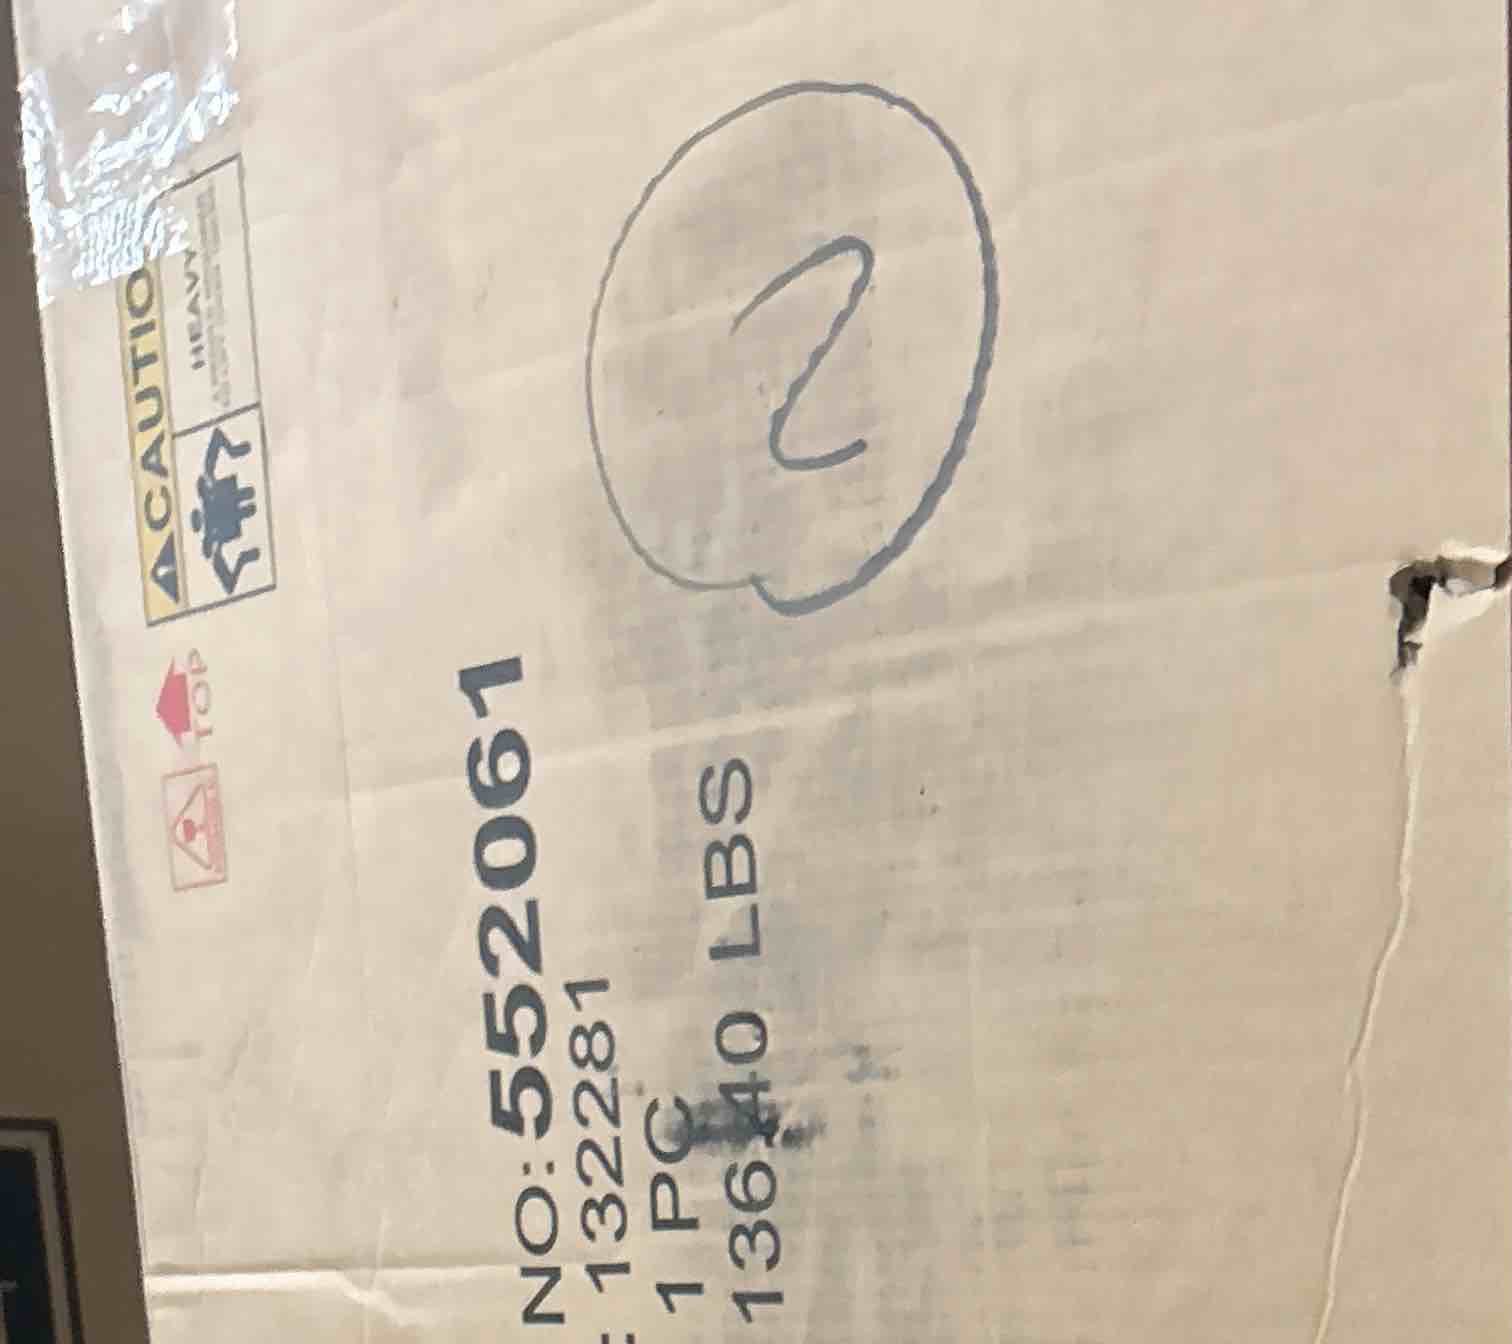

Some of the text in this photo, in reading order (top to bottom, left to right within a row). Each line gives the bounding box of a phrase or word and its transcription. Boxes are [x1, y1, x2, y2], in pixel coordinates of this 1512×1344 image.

[126, 267, 173, 532] CAUTIO
[187, 648, 213, 738] TOP
[699, 756, 761, 961] LBS
[563, 977, 631, 1294] 132281
[644, 1096, 700, 1231] PC
[655, 1281, 704, 1314] 1
